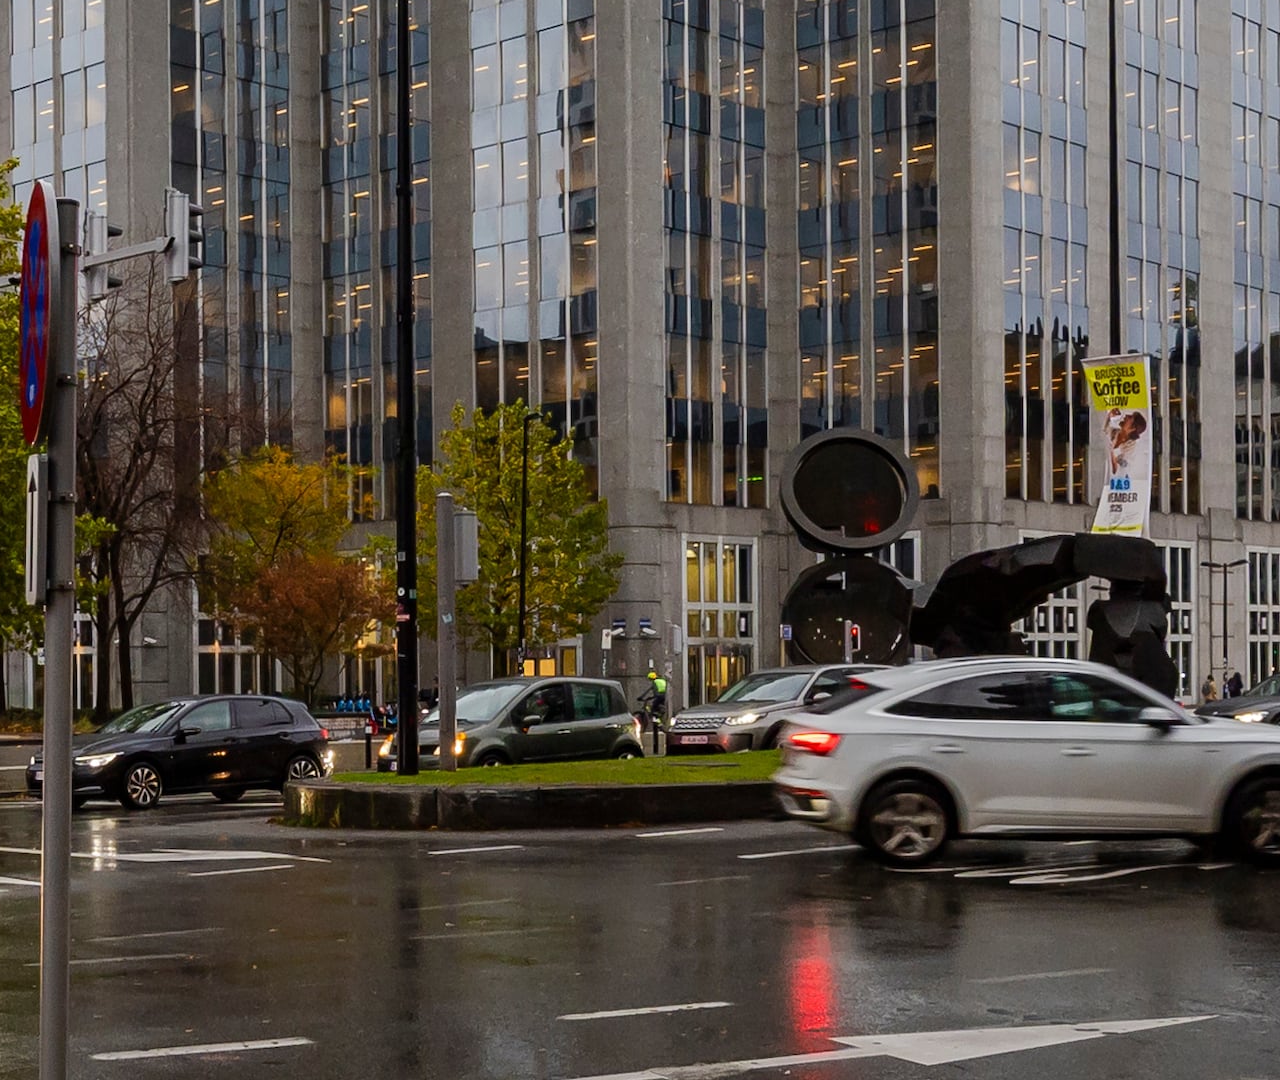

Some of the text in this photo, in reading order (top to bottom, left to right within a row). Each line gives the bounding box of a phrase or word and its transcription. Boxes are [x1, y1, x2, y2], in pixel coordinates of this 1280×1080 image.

[1094, 366, 1136, 380] BRUSSELS
[1093, 378, 1140, 396] Coffee
[1103, 396, 1129, 407] SHOW
